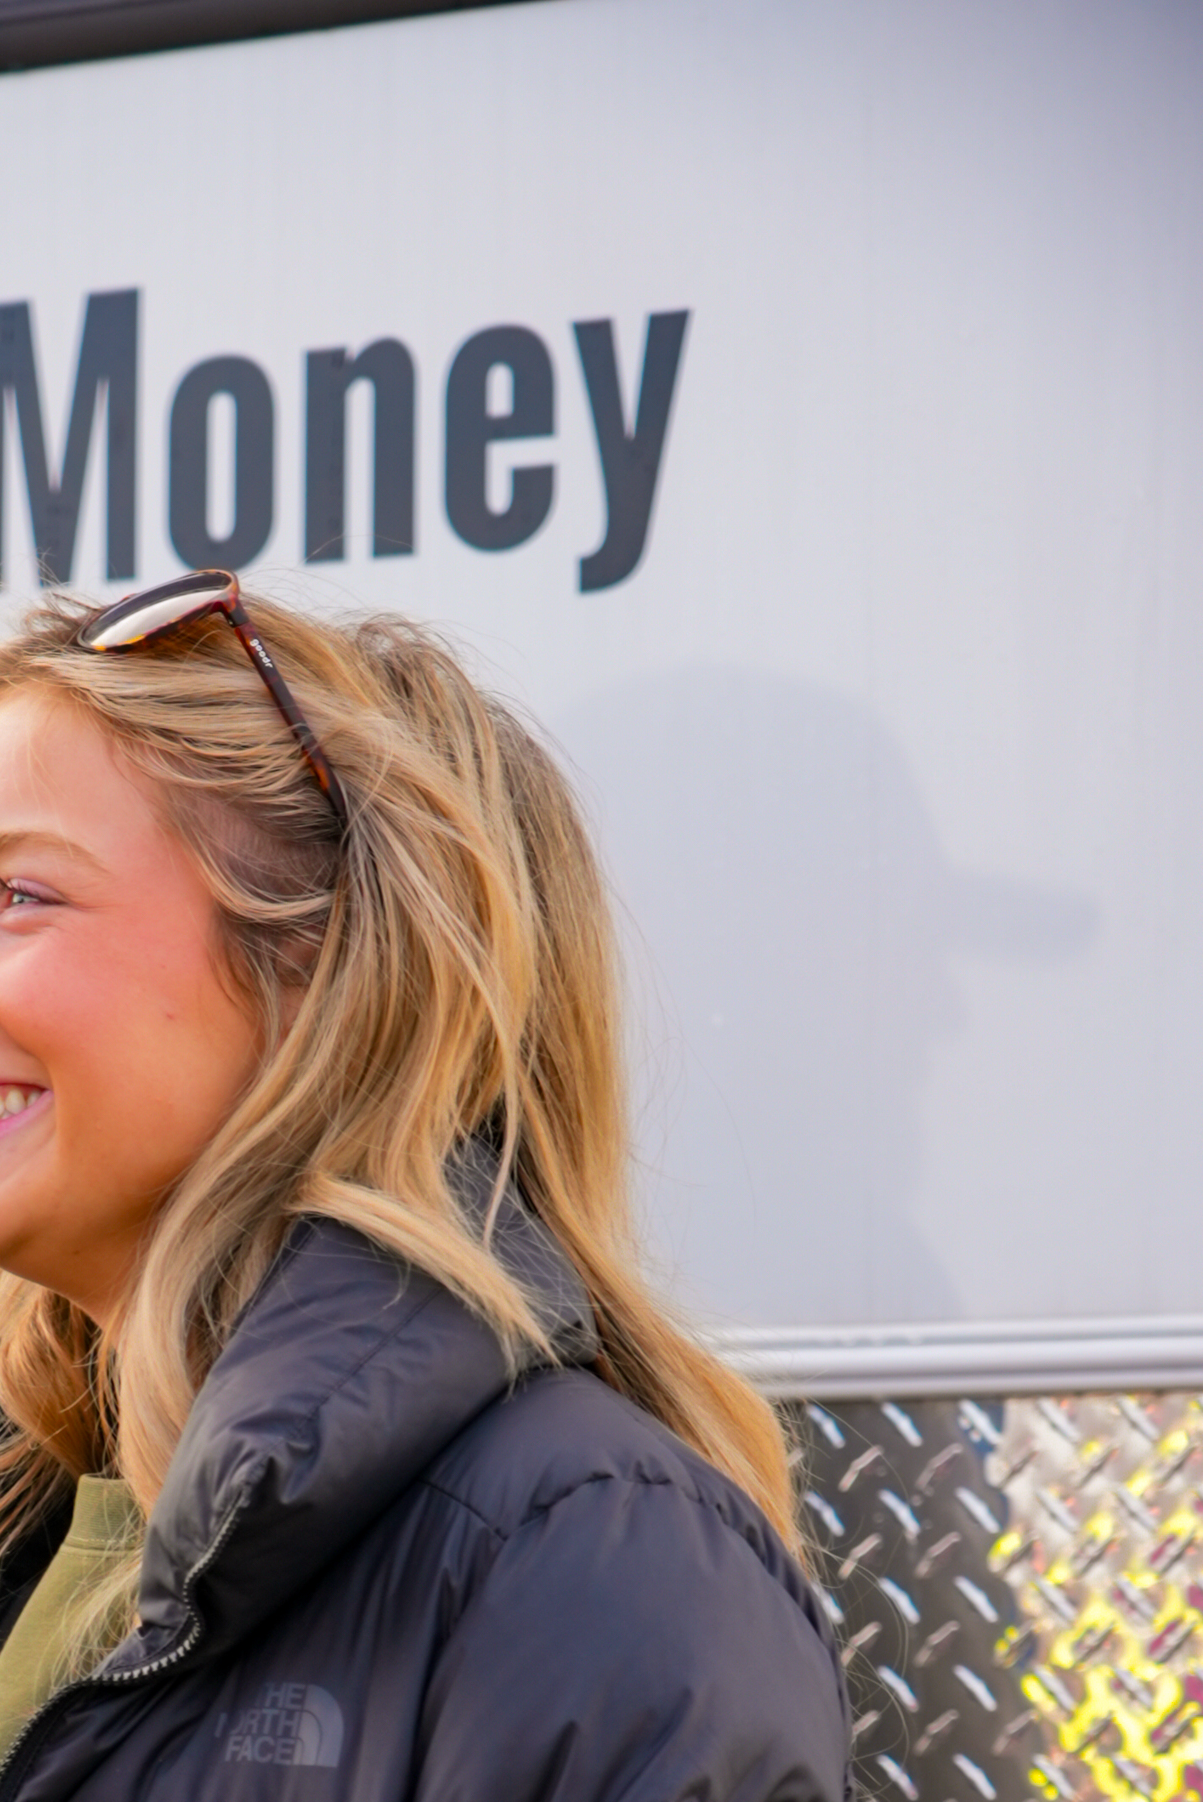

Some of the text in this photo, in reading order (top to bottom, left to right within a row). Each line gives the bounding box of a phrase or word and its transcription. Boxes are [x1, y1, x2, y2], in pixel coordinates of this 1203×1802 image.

[250, 638, 274, 669] goodr
[256, 1682, 306, 1709] HE
[224, 1735, 296, 1766] FACE
